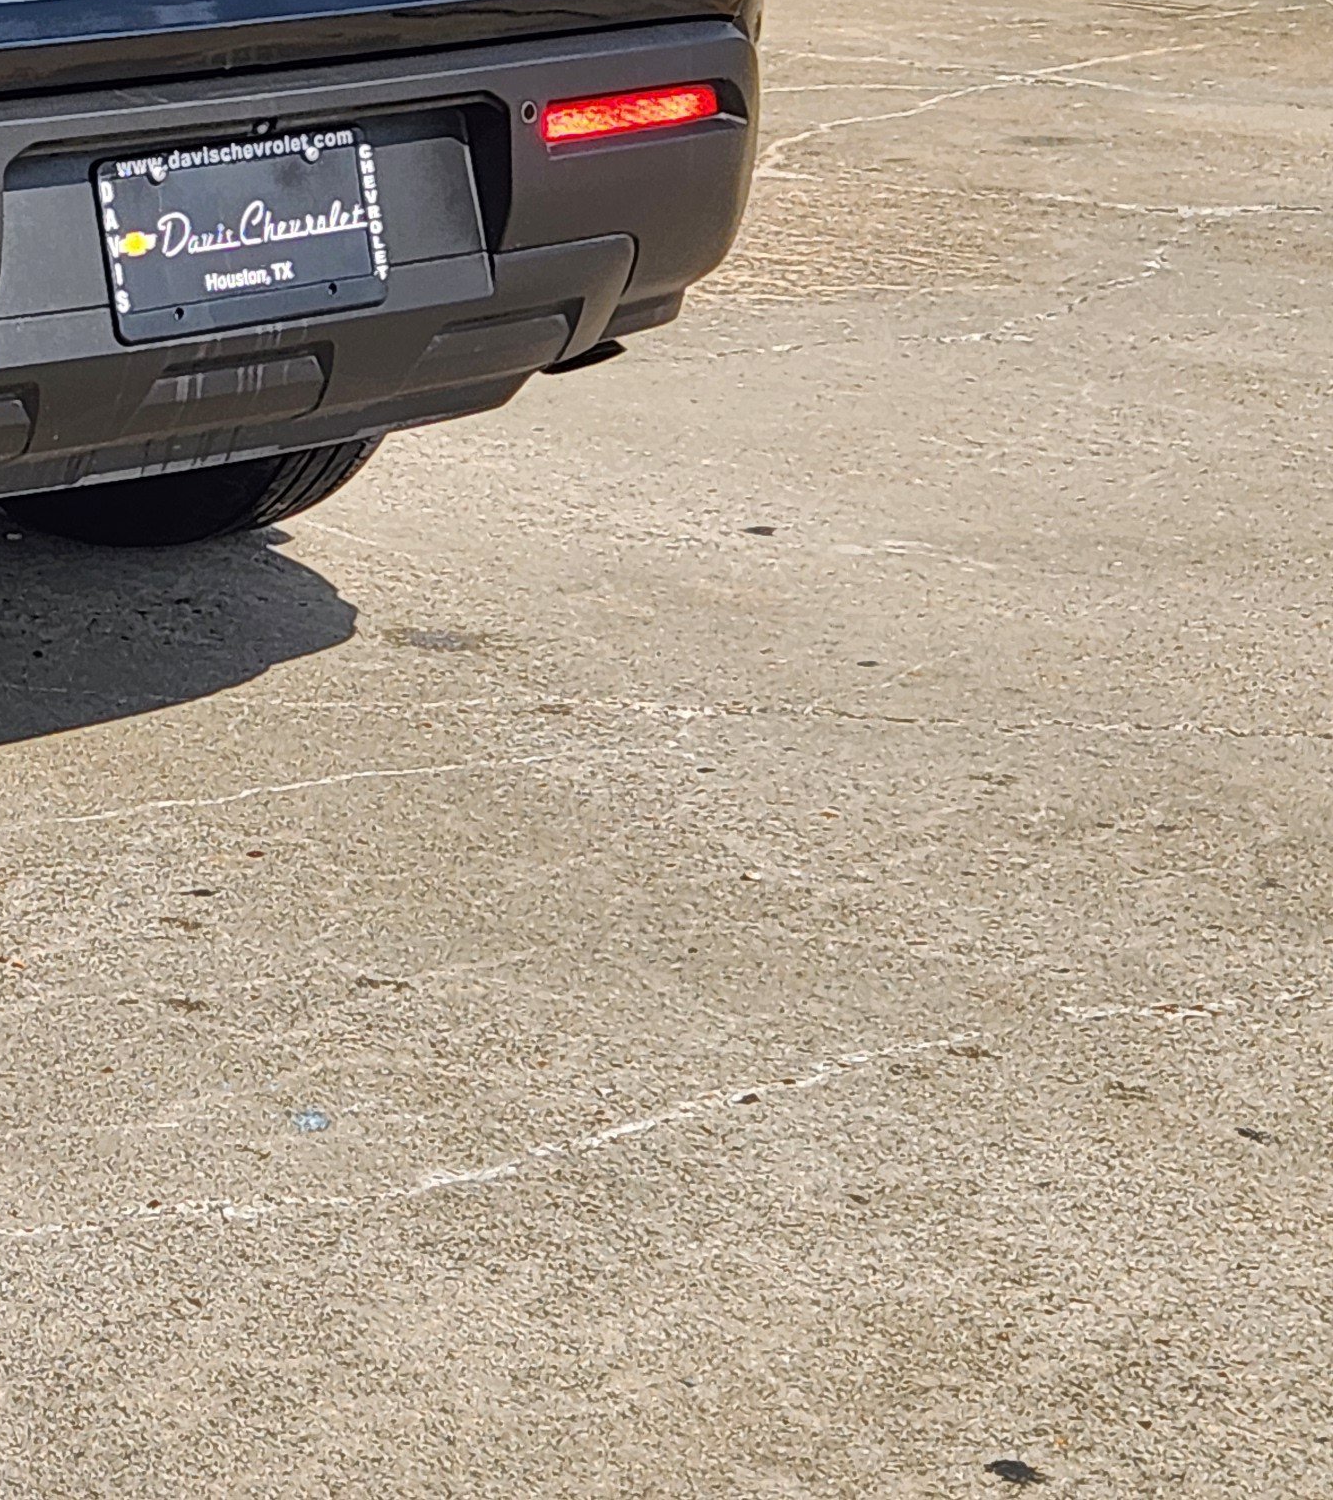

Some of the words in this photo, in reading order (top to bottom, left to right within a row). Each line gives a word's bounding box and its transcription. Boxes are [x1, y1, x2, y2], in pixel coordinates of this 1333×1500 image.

[116, 129, 354, 179] www.davischevrolet.com
[157, 212, 241, 257] Davis
[239, 200, 368, 246] Chevrolet
[359, 143, 390, 281] CHEVROLET
[99, 181, 131, 314] DAVIS
[270, 260, 296, 280] TX
